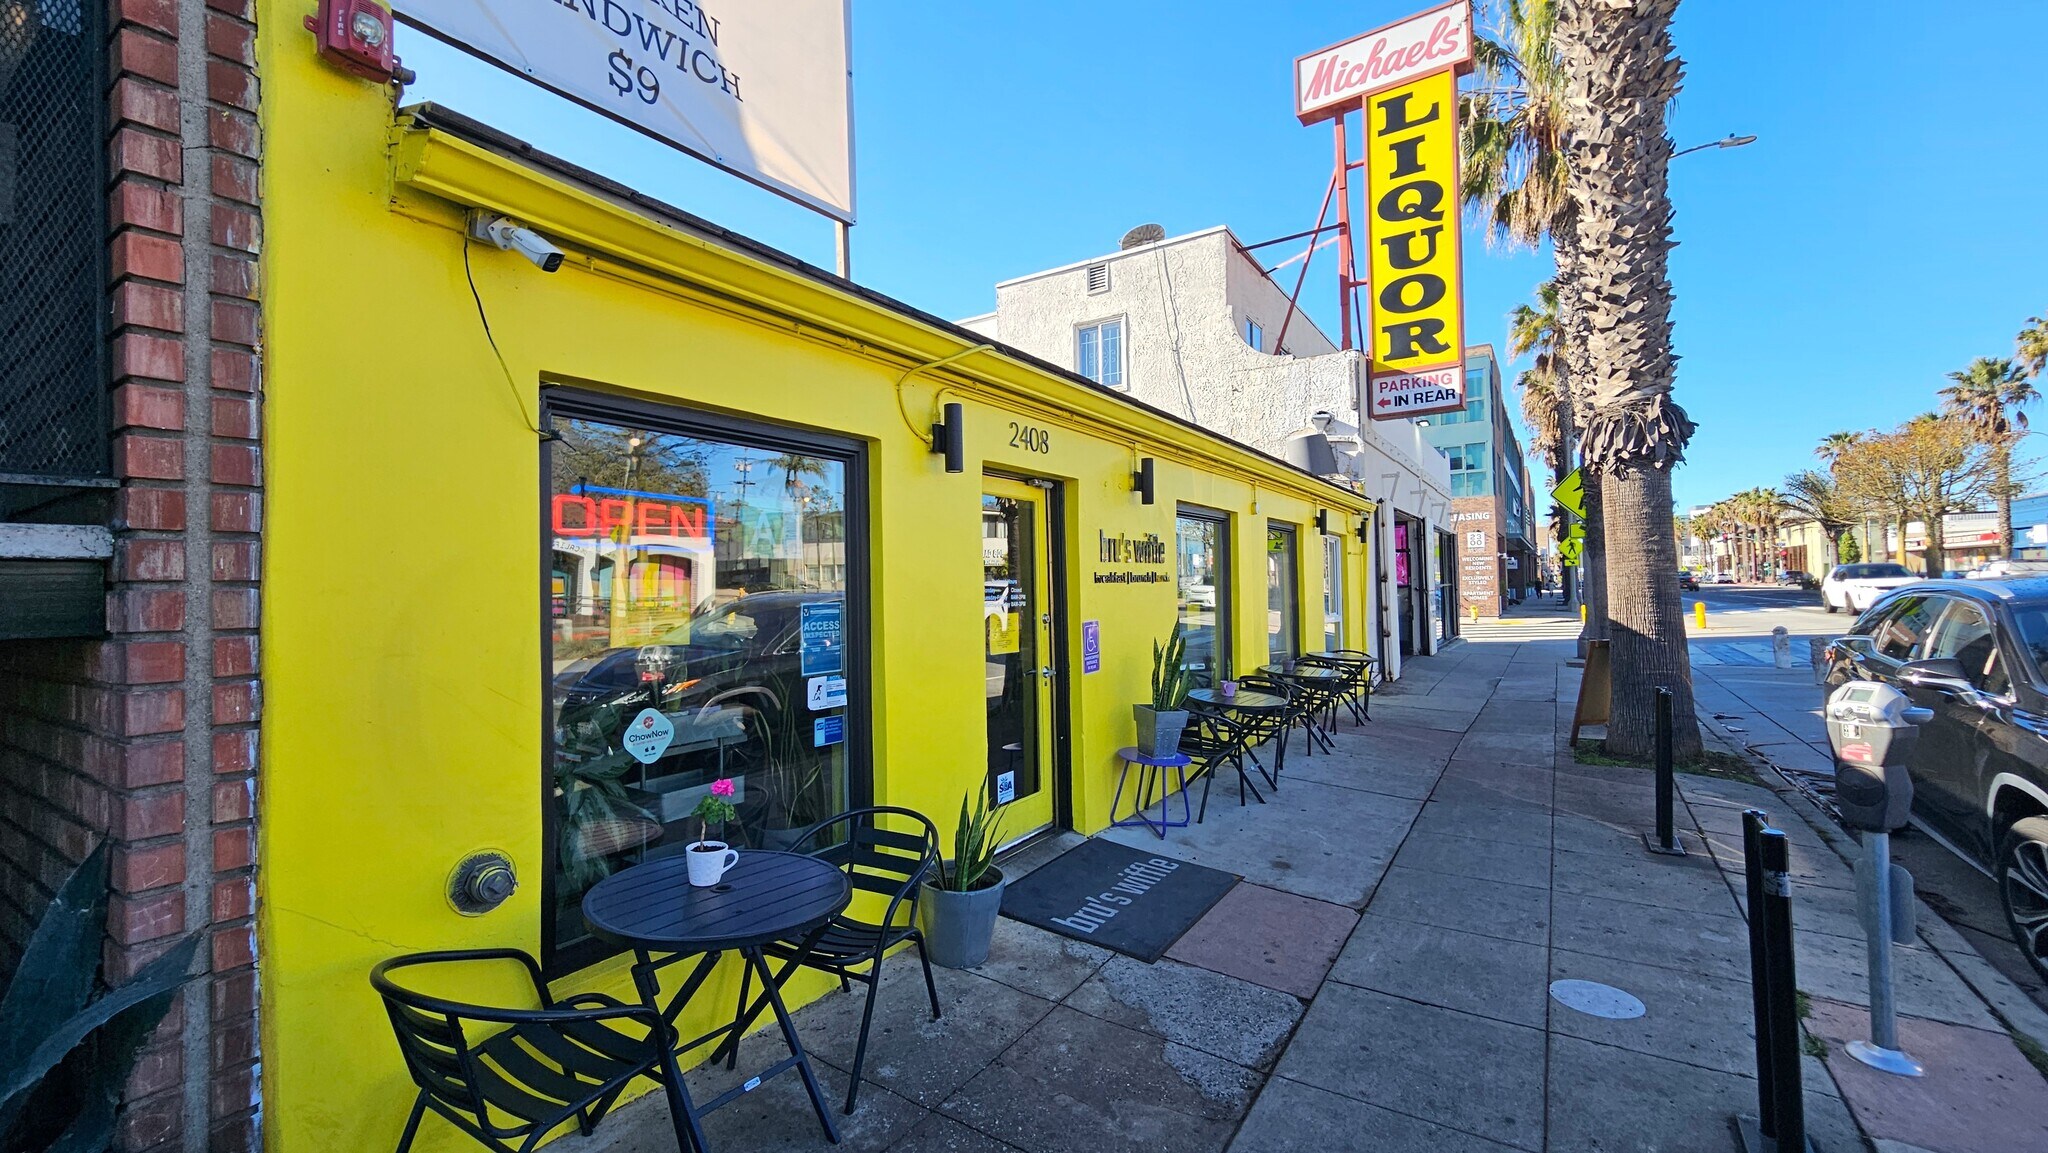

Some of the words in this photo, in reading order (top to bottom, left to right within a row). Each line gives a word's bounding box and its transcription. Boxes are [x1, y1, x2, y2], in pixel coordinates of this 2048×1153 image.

[608, 48, 660, 105] $9
[1304, 15, 1460, 103] Michaels
[1376, 91, 1452, 362] LIQUOR
[1379, 372, 1453, 394] PARKING
[1394, 394, 1409, 407] IN
[1413, 388, 1456, 405] REAR
[1008, 421, 1049, 455] 2408
[552, 493, 703, 543] OPEN
[803, 620, 840, 631] ACCESS
[629, 729, 669, 743] ChowNow
[1050, 892, 1133, 934] bru's
[1111, 858, 1180, 895] wiffle
